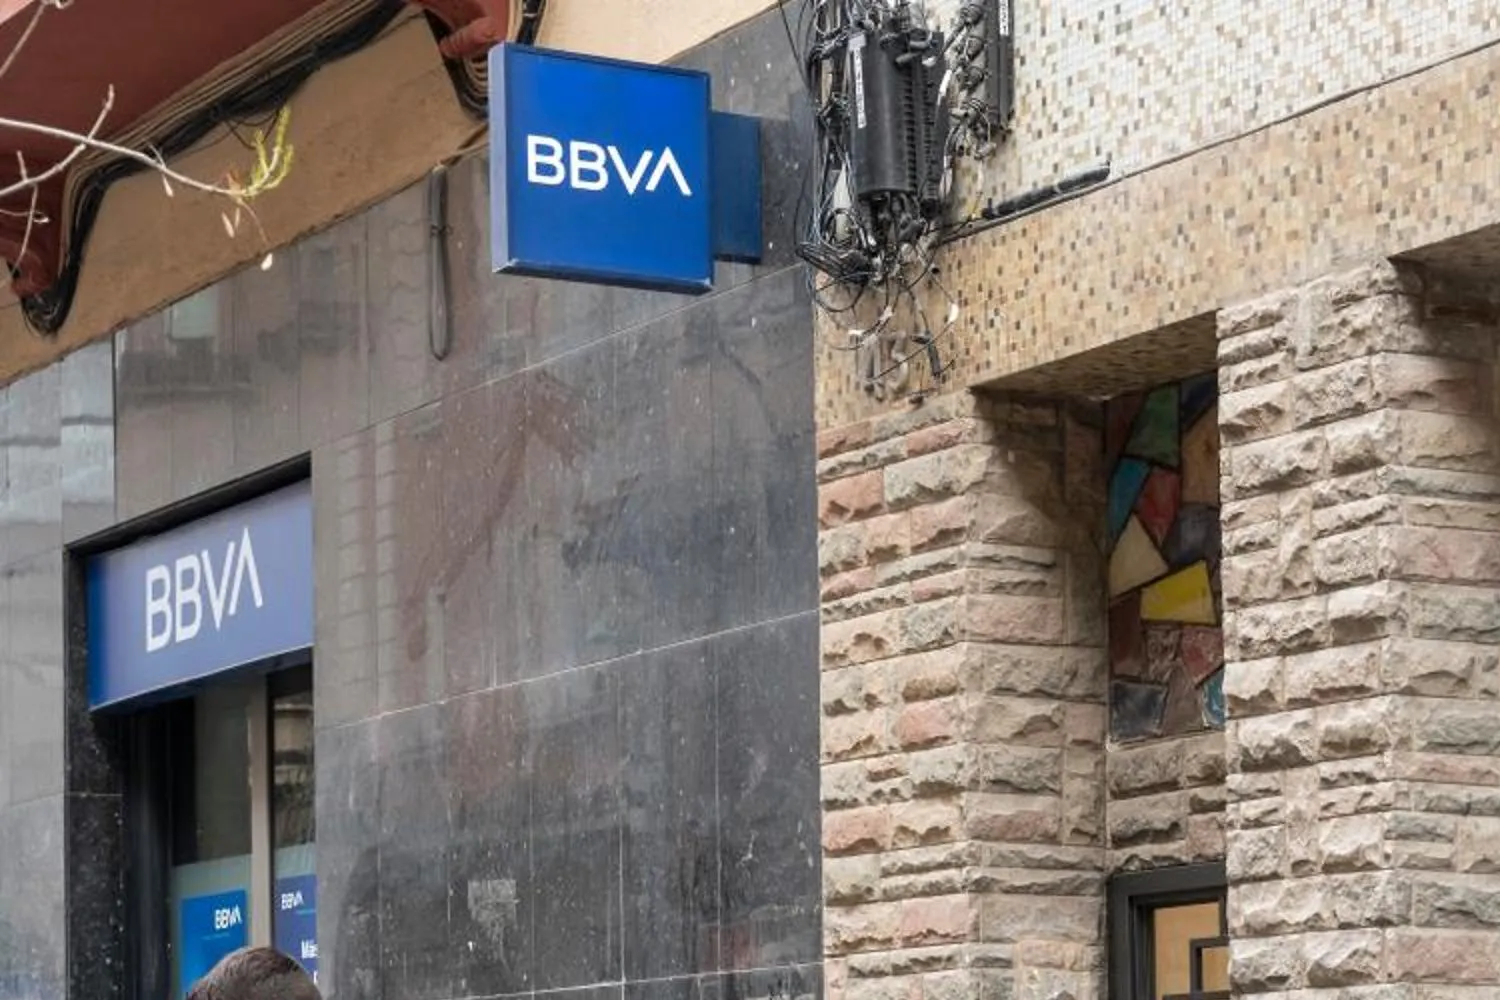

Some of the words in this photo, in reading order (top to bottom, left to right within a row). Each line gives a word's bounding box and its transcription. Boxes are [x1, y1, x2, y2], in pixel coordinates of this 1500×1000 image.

[527, 134, 692, 196] BBVA
[146, 527, 263, 652] BBVA
[214, 904, 242, 930] BBVA
[281, 891, 304, 910] BBVA
